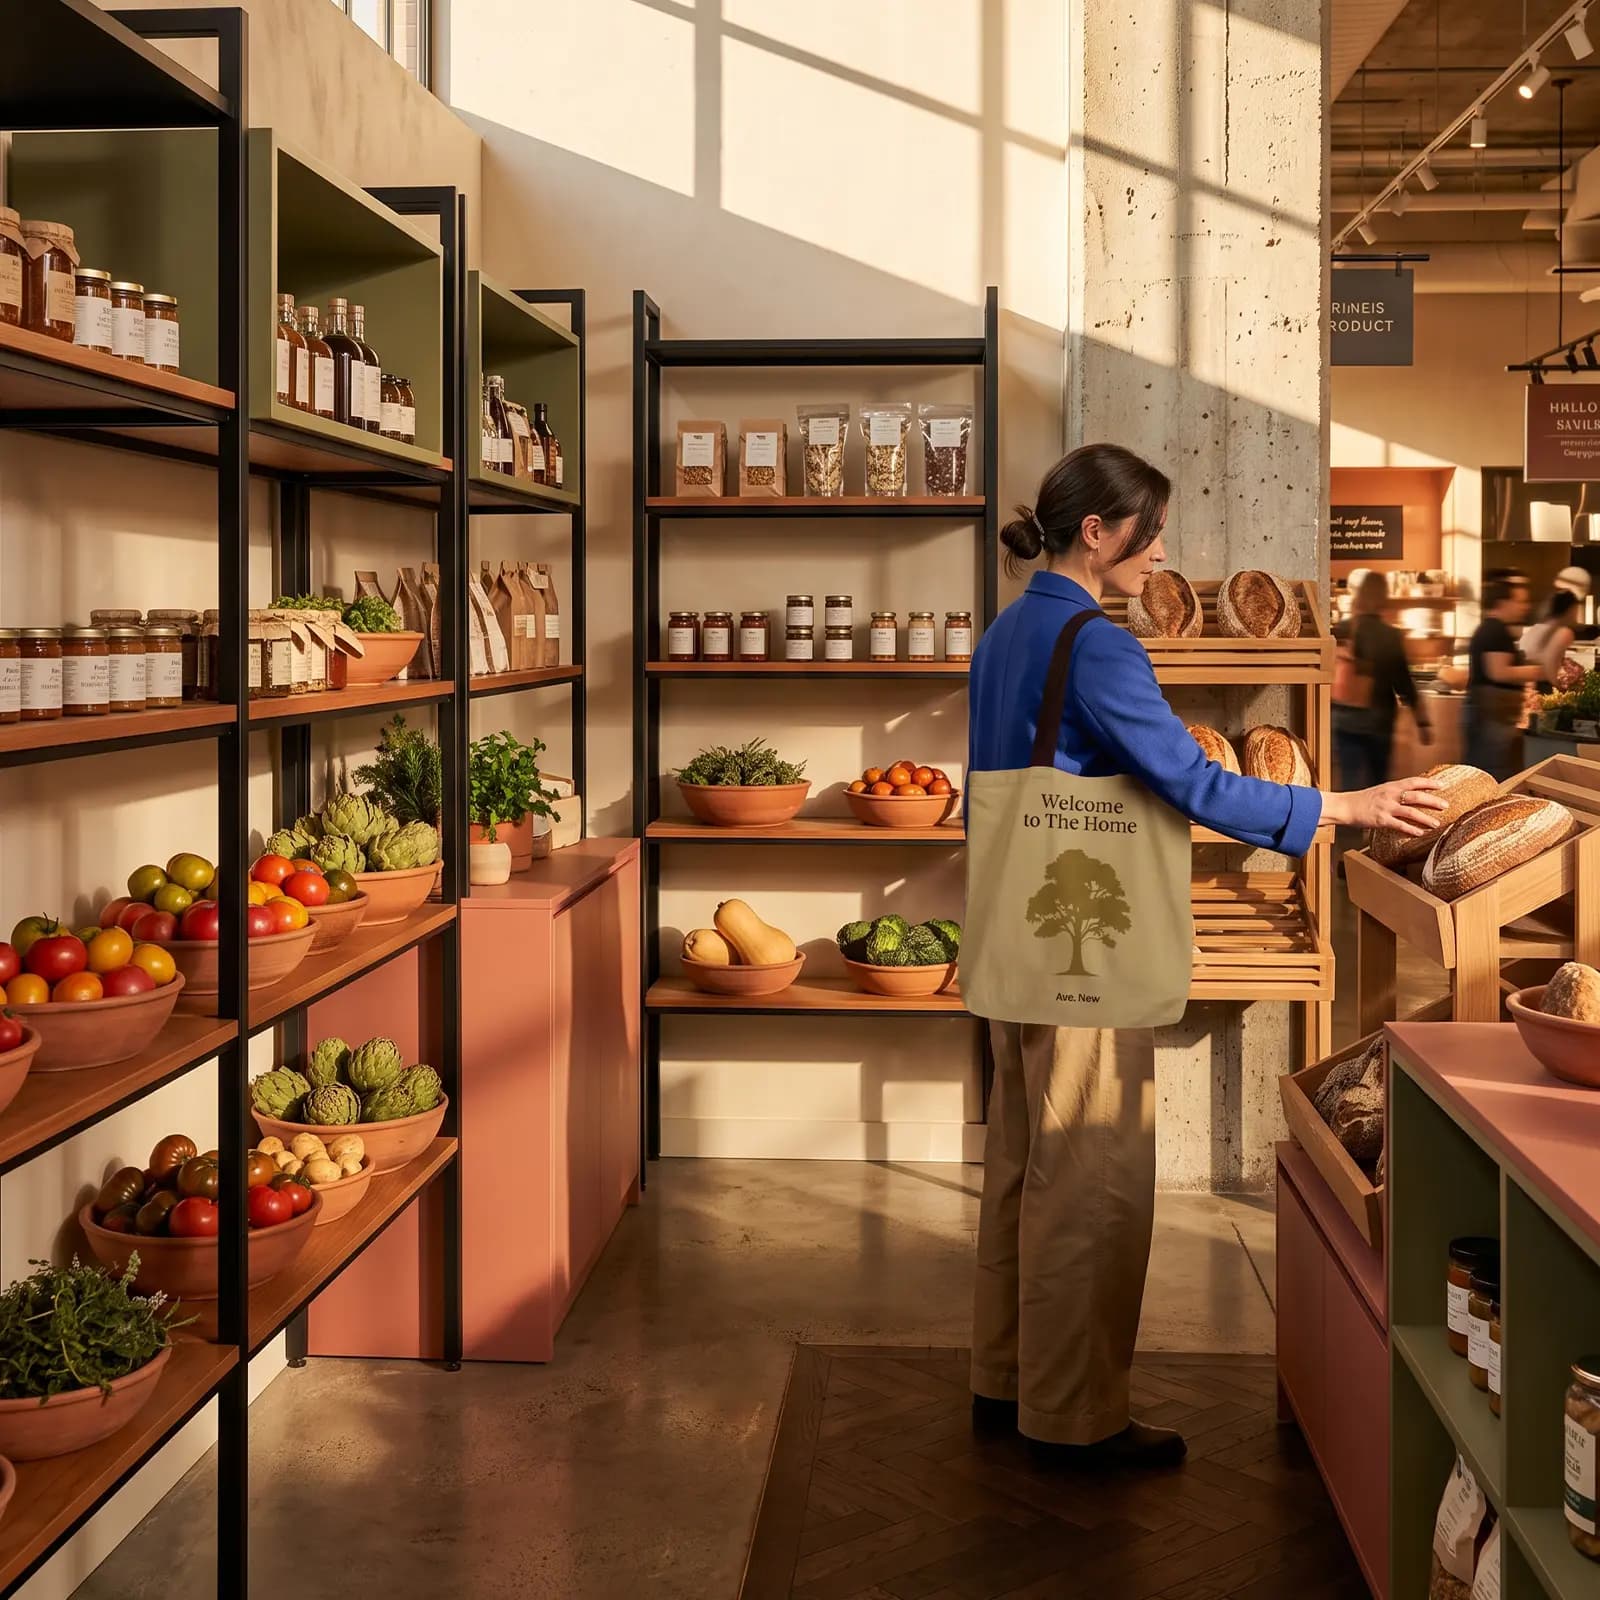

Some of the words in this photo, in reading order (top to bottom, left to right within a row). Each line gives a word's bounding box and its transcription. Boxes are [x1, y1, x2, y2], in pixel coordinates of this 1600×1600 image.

[1041, 793, 1124, 814] Welcome
[1024, 814, 1041, 828] to
[1045, 813, 1079, 830] The
[1083, 815, 1137, 834] Home
[1056, 992, 1076, 1002] Ave.
[1078, 993, 1101, 1003] New
